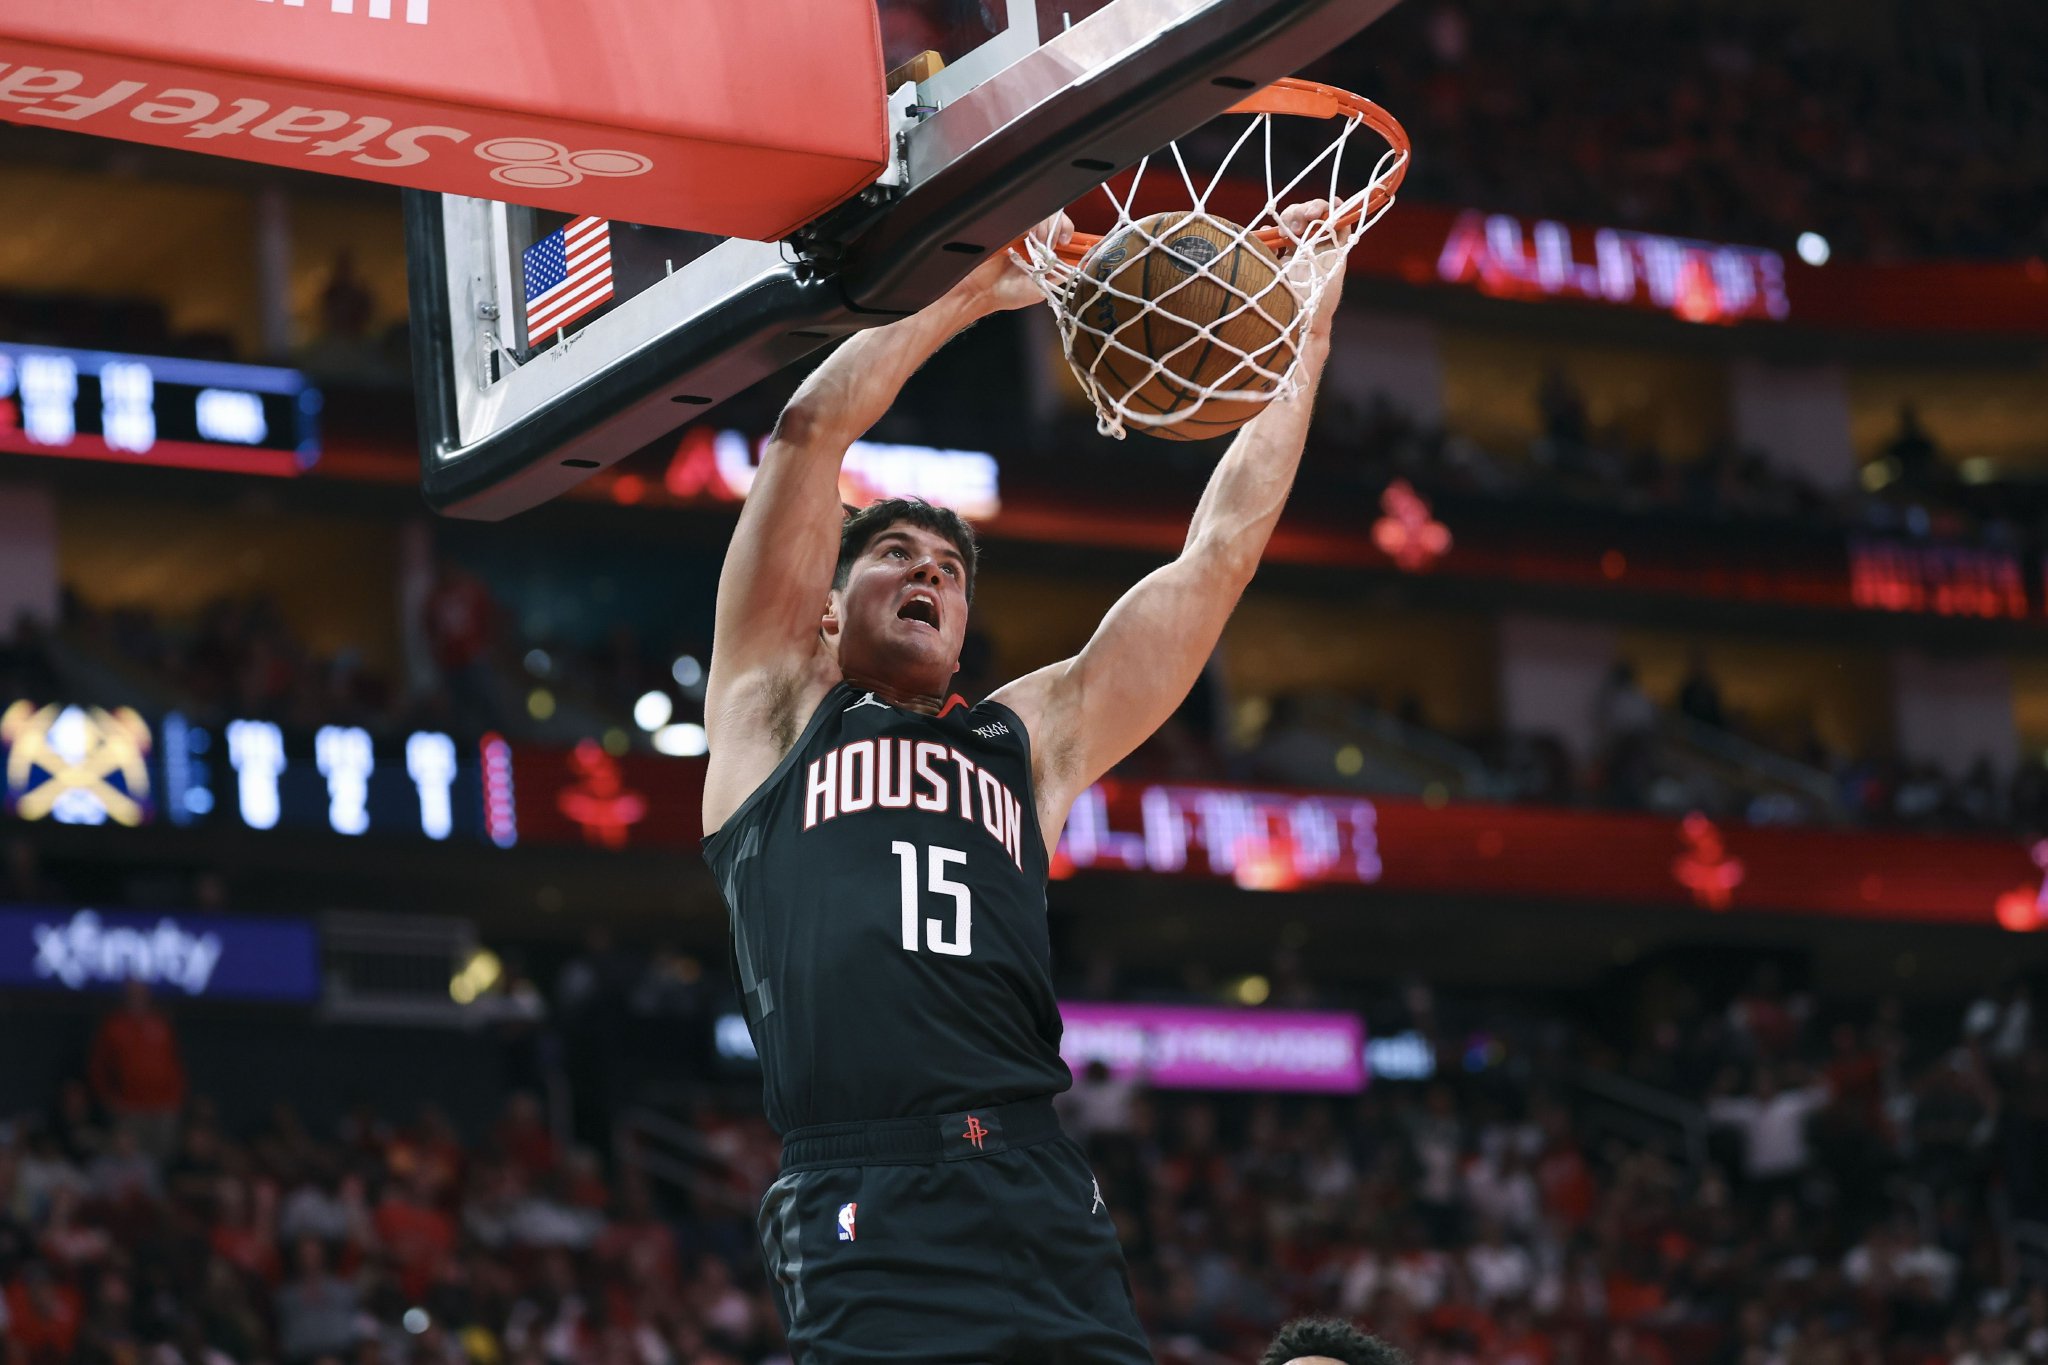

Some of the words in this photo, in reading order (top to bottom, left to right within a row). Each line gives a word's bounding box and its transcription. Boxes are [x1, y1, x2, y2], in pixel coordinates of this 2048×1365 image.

[0, 63, 472, 168] StateFa
[804, 737, 1024, 874] HOUSTON
[891, 840, 972, 957] 15
